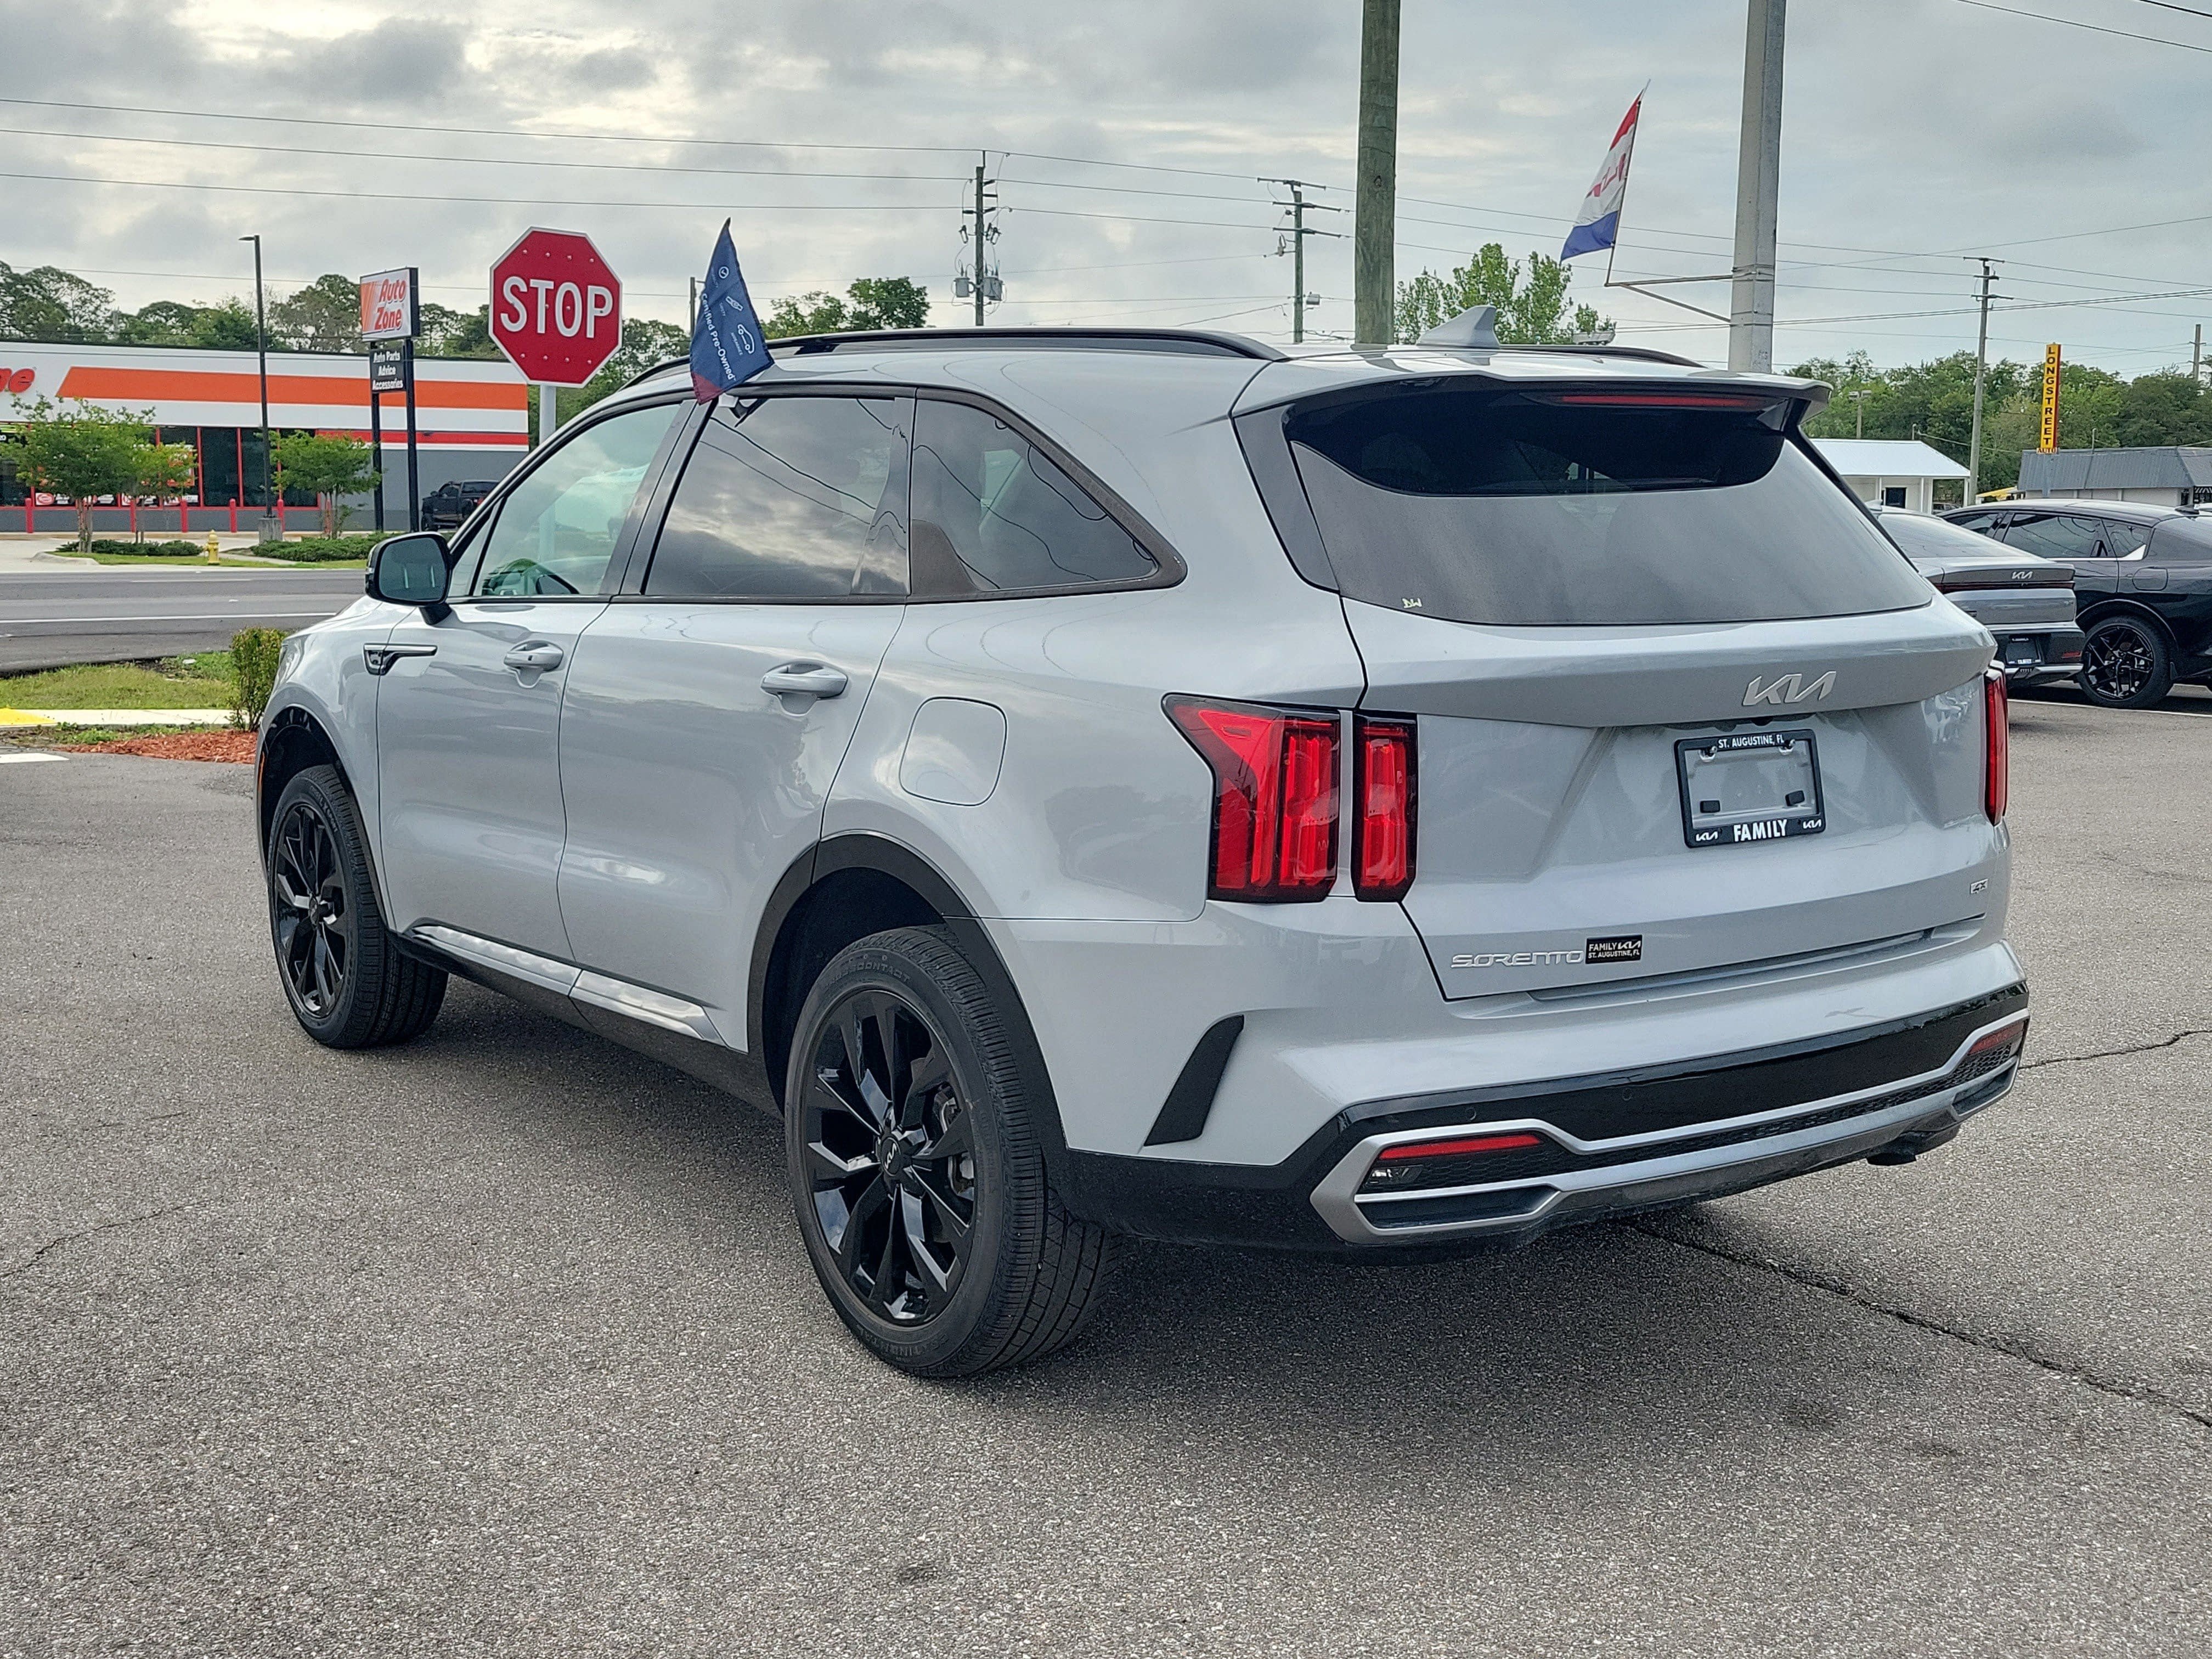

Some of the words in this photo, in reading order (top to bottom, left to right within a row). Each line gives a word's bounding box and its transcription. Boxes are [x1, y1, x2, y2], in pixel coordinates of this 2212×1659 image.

[379, 279, 407, 302] Auto
[500, 276, 613, 338] STOP
[374, 307, 403, 331] Zone
[373, 352, 385, 363] Auto
[386, 351, 400, 362] Parts
[378, 366, 396, 376] Advice
[372, 379, 404, 390] Accessories
[2044, 347, 2056, 445] LONGSTREET
[1742, 671, 1837, 706] KIA
[1718, 739, 1729, 748] ST.
[1732, 735, 1775, 747] AUGUSTINE,
[1776, 734, 1784, 743] FL
[1696, 831, 1718, 842] KIA
[1734, 819, 1787, 842] FAMILY
[1803, 819, 1822, 829] KIA
[1589, 942, 1617, 952] FAMILY
[1617, 940, 1641, 950] KIA
[1598, 950, 1632, 958] AUGUSTINE,
[1451, 950, 1584, 968] SORENTO
